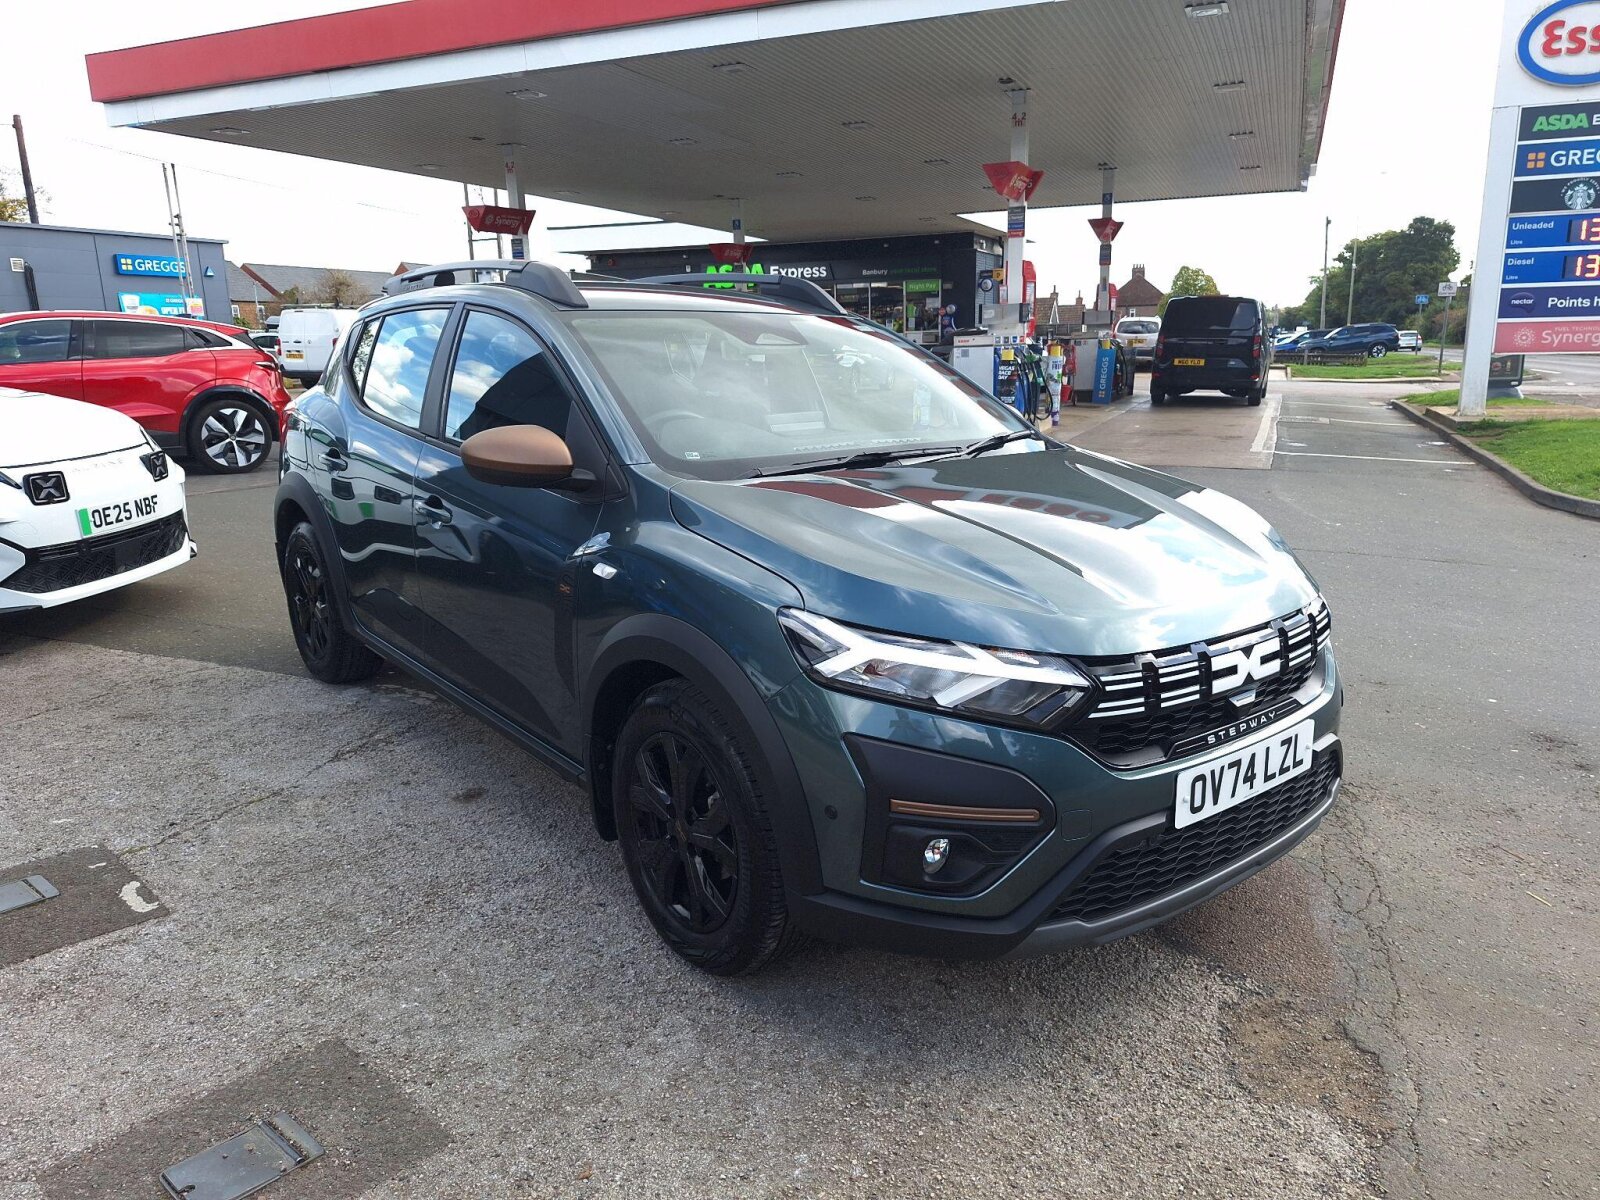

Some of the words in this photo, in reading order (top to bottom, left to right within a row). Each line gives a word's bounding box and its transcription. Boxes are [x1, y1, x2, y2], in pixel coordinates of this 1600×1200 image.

[1532, 113, 1589, 132] ASDA
[1512, 221, 1554, 231] Unleaded
[134, 259, 186, 273] GREGGS
[1507, 257, 1535, 266] Diesel
[1575, 254, 1600, 278] 13
[703, 263, 765, 289] ASA
[769, 265, 827, 278] Express
[862, 268, 888, 276] Banbury
[1547, 296, 1591, 308] Points
[1541, 330, 1600, 347] Synerg
[1099, 356, 1109, 390] GREGGS
[91, 502, 133, 528] OE25
[134, 494, 158, 518] NBF
[1207, 710, 1276, 744] STEPWAY
[1189, 752, 1257, 815] OV74
[1263, 733, 1304, 784] LZL
